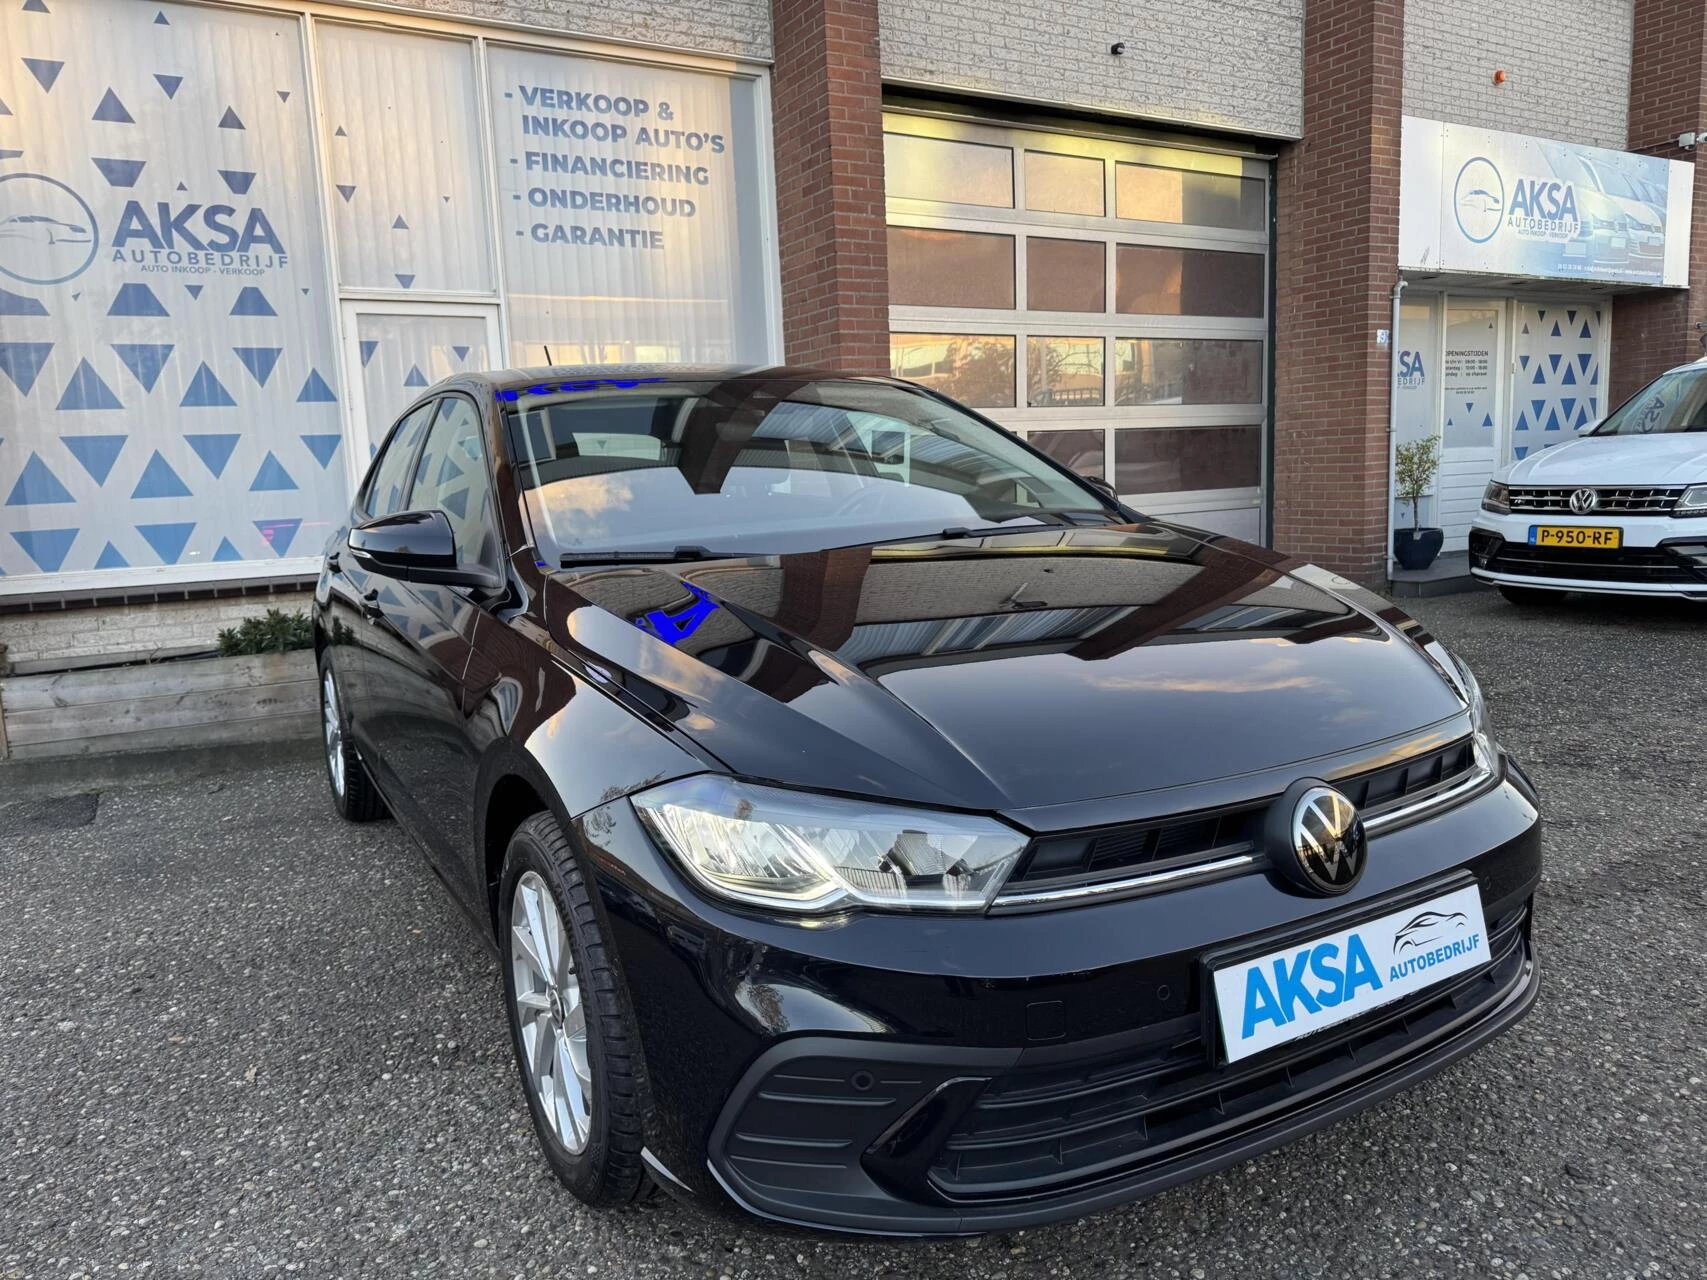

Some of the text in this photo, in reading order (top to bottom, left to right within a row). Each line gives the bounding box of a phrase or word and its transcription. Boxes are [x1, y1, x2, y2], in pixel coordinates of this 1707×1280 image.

[519, 85, 649, 117] VERKOOP
[658, 101, 674, 121] &
[522, 115, 725, 153] INKOOP AUTO'S
[525, 151, 709, 185] FINANCIERING
[528, 187, 696, 217] ONDERHOUD
[1508, 178, 1578, 222] AKSA
[112, 200, 286, 254] AKSA
[531, 223, 664, 249] GARANTIE
[1507, 217, 1579, 233] AUTOBEDRIJF
[112, 249, 288, 268] AUTOBEDRIJF
[140, 265, 169, 273] AUTO
[171, 266, 211, 274] INKOOP
[218, 267, 265, 276] VERKOOP
[1541, 529, 1613, 545] P-950-RF
[1242, 933, 1383, 1039] AKSA
[1389, 933, 1480, 982] AUTOBEDRIJF
